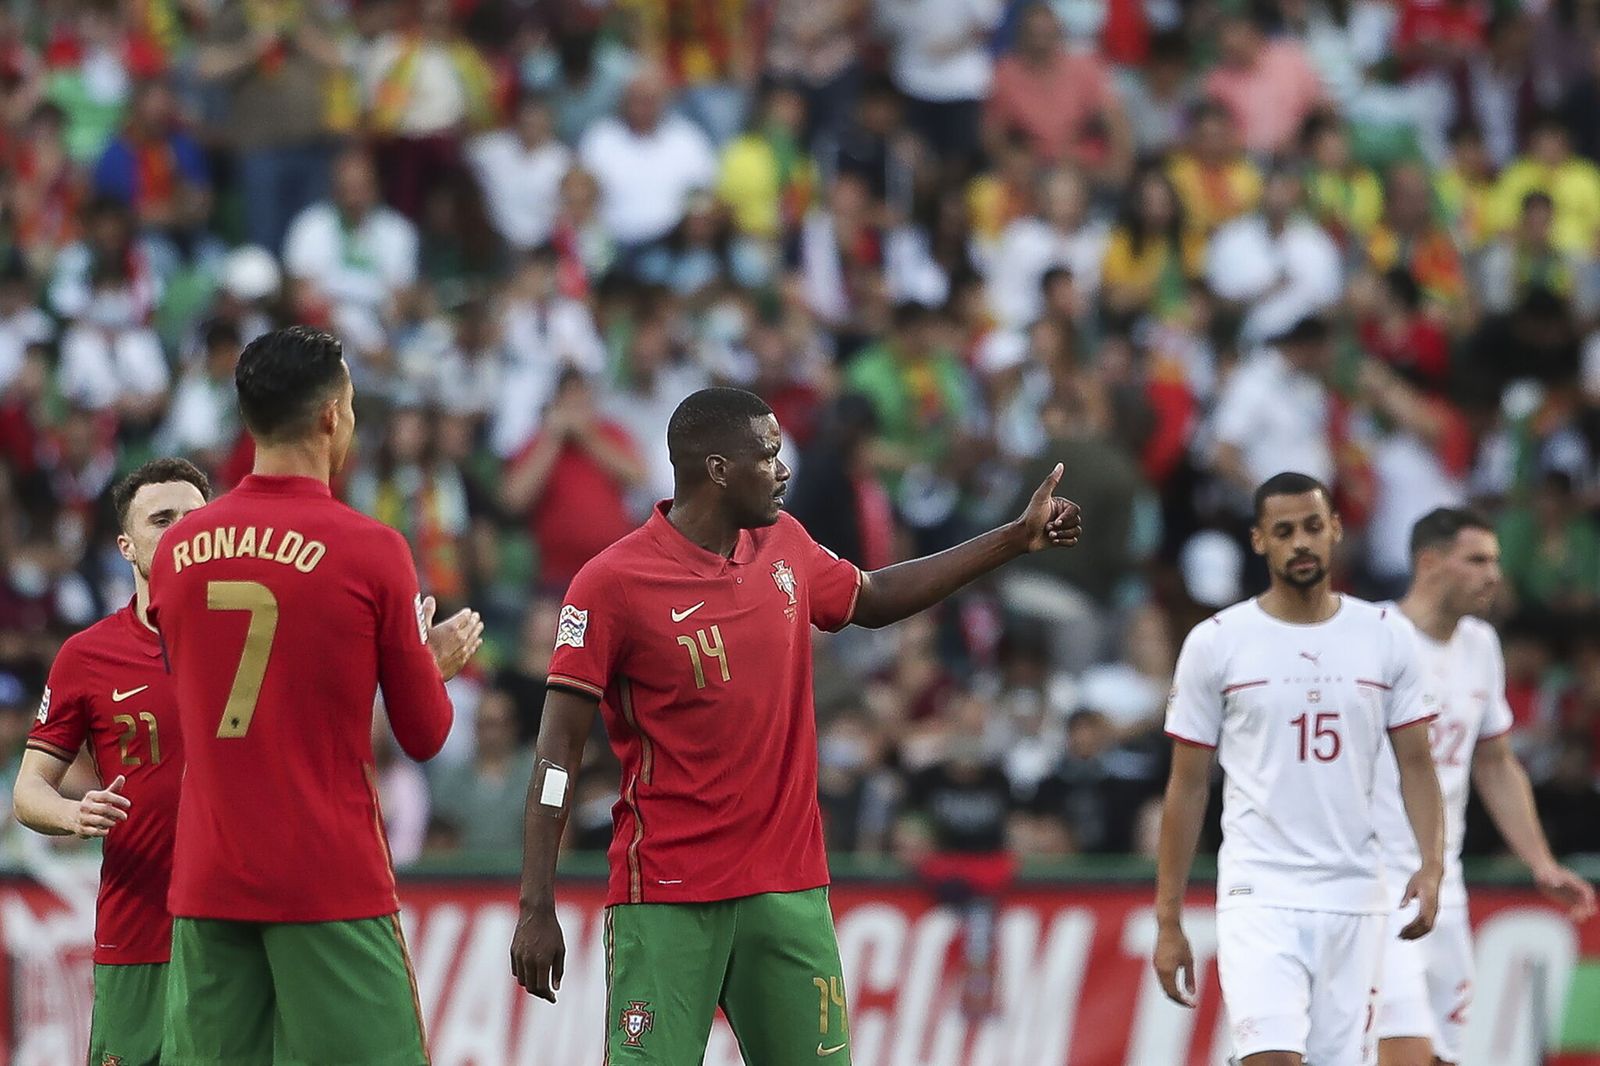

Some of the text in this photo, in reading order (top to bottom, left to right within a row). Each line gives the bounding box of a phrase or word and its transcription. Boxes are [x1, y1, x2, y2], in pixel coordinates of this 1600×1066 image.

[172, 526, 326, 574] RONALDO
[207, 581, 279, 738] 7
[676, 624, 731, 689] 14
[113, 711, 160, 766] 21
[1289, 712, 1341, 763] 15
[813, 975, 848, 1034] 14
